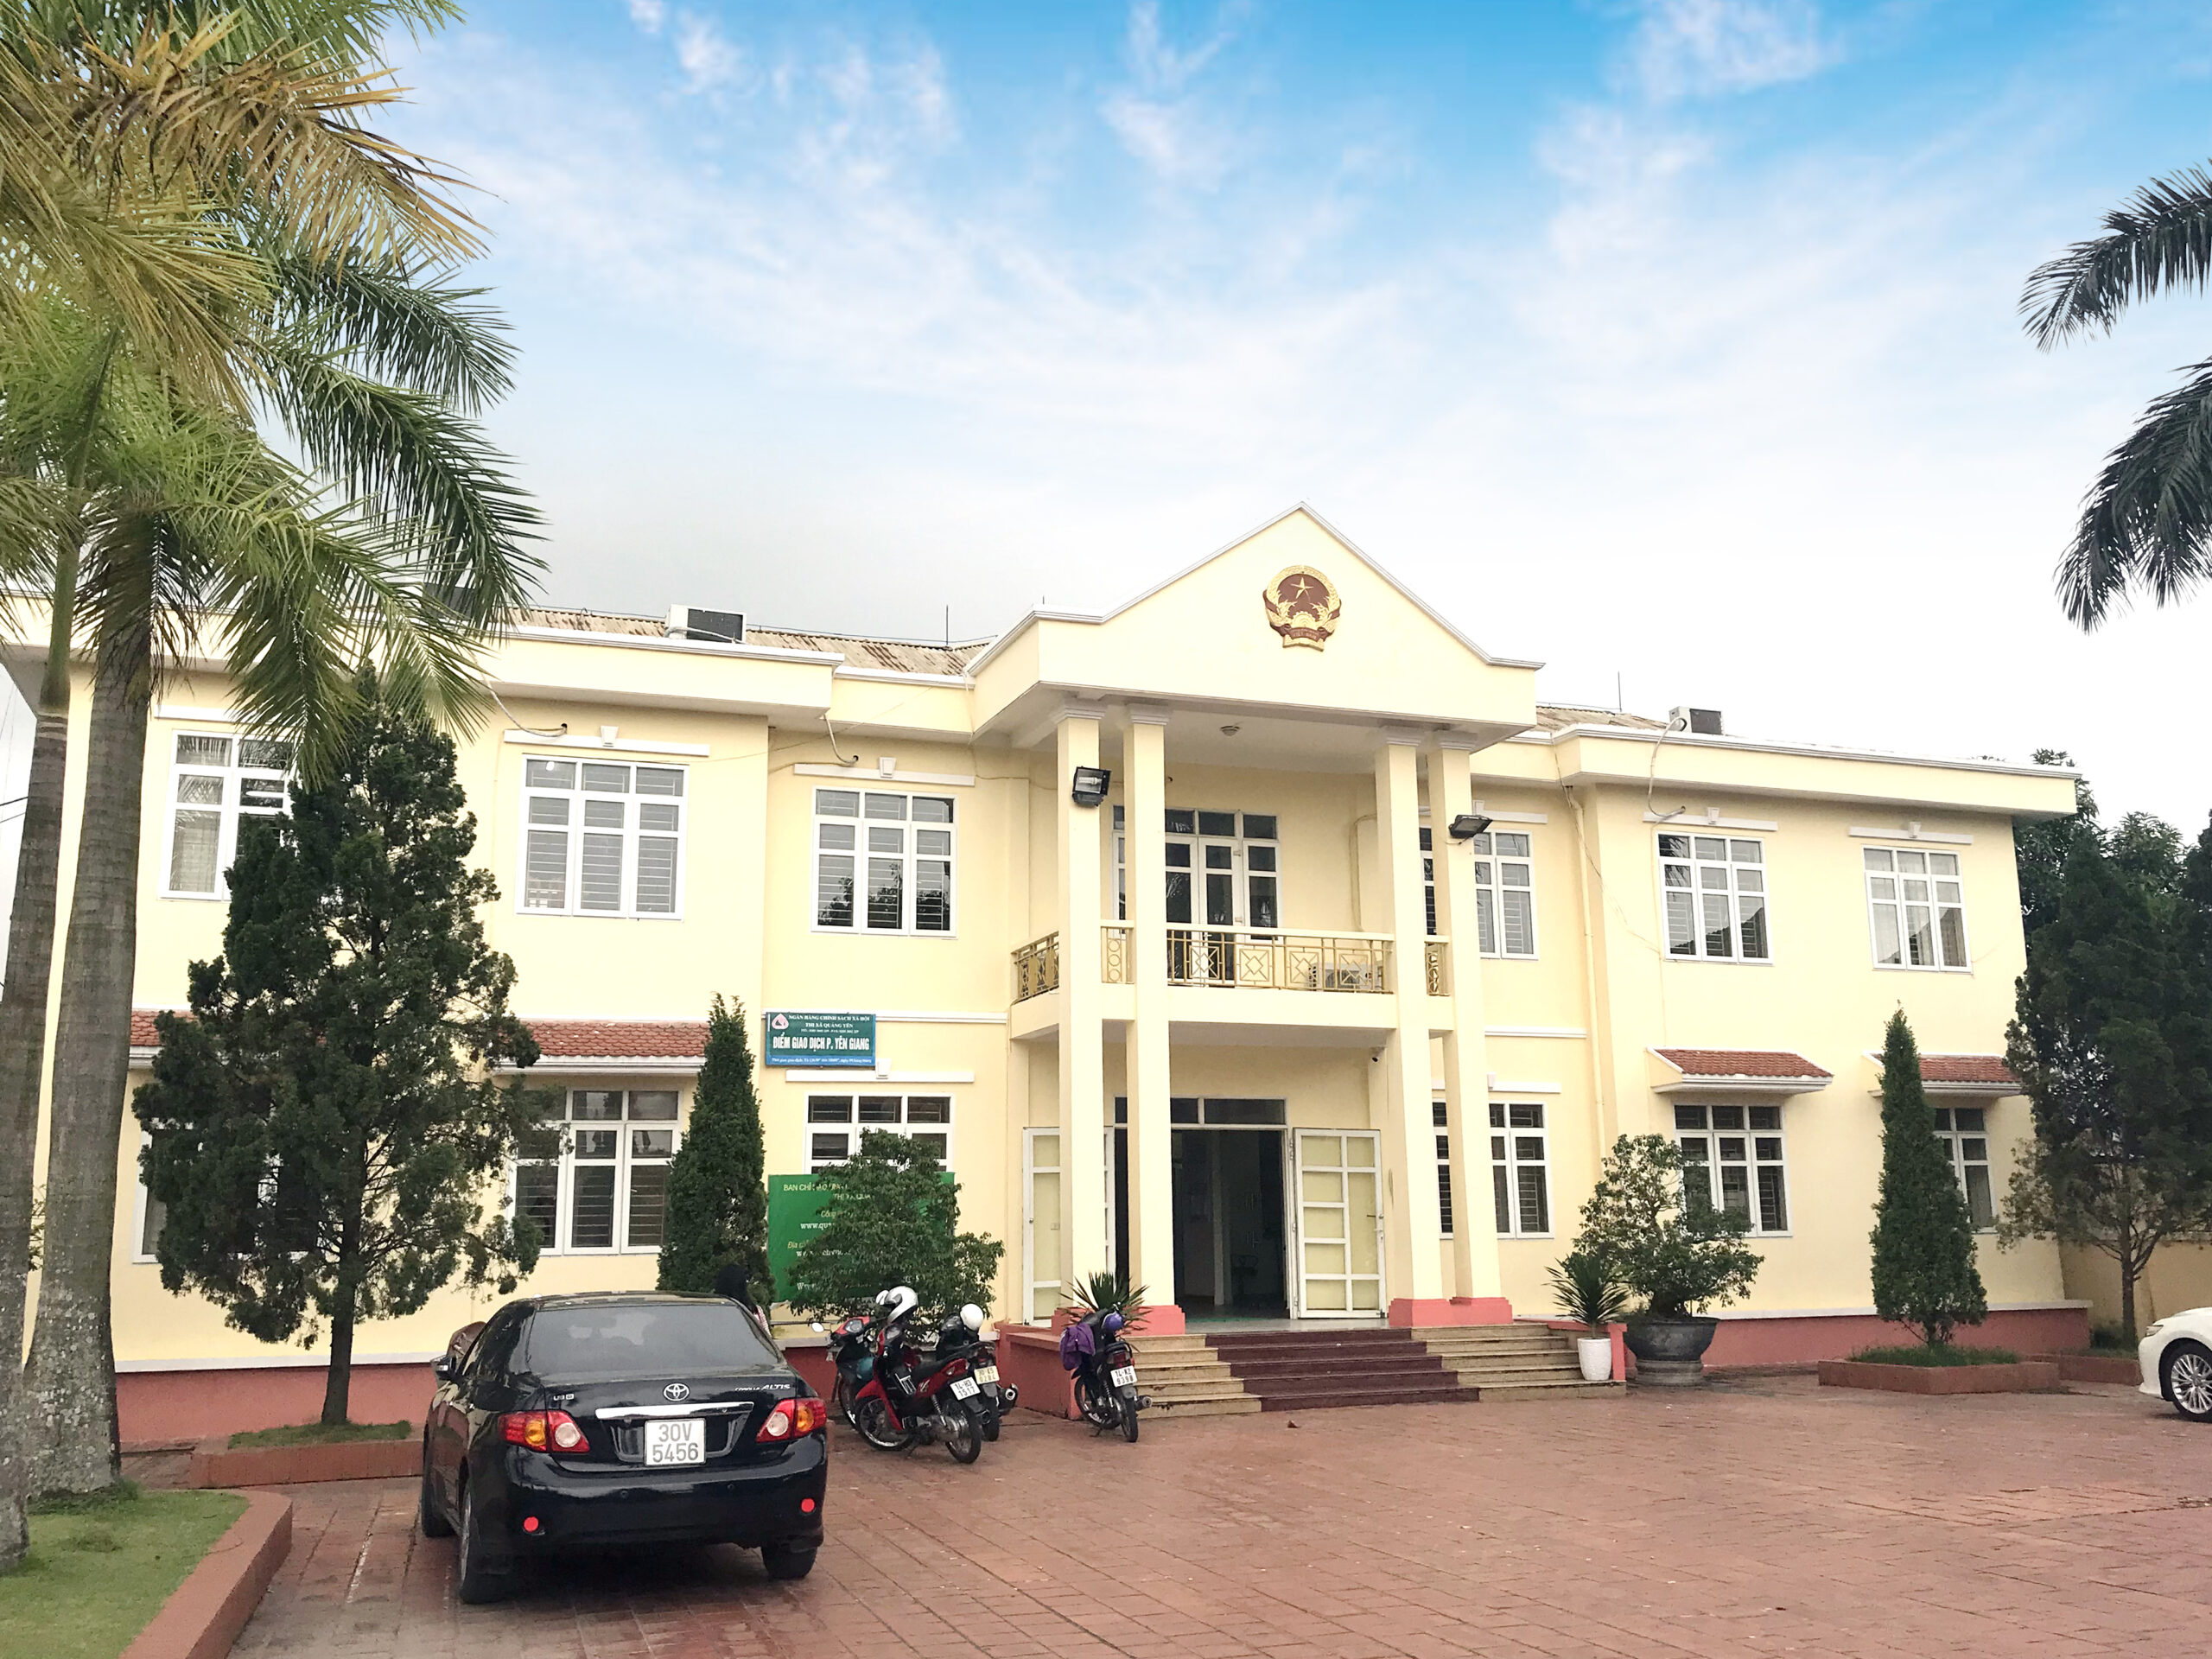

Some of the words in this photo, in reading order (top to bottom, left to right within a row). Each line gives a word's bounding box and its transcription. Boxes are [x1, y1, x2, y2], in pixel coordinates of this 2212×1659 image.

[772, 1032, 791, 1049] ĐIỂM
[791, 1036, 808, 1049] GIAO
[809, 1037, 825, 1052] DỊCH
[826, 1037, 833, 1050] P.
[835, 1035, 848, 1050] YÊN
[849, 1038, 870, 1051] GIANG
[798, 1182, 811, 1191] CHỈ
[958, 1386, 976, 1397] 1517
[658, 1422, 692, 1442] 30V
[652, 1442, 699, 1463] 5456
